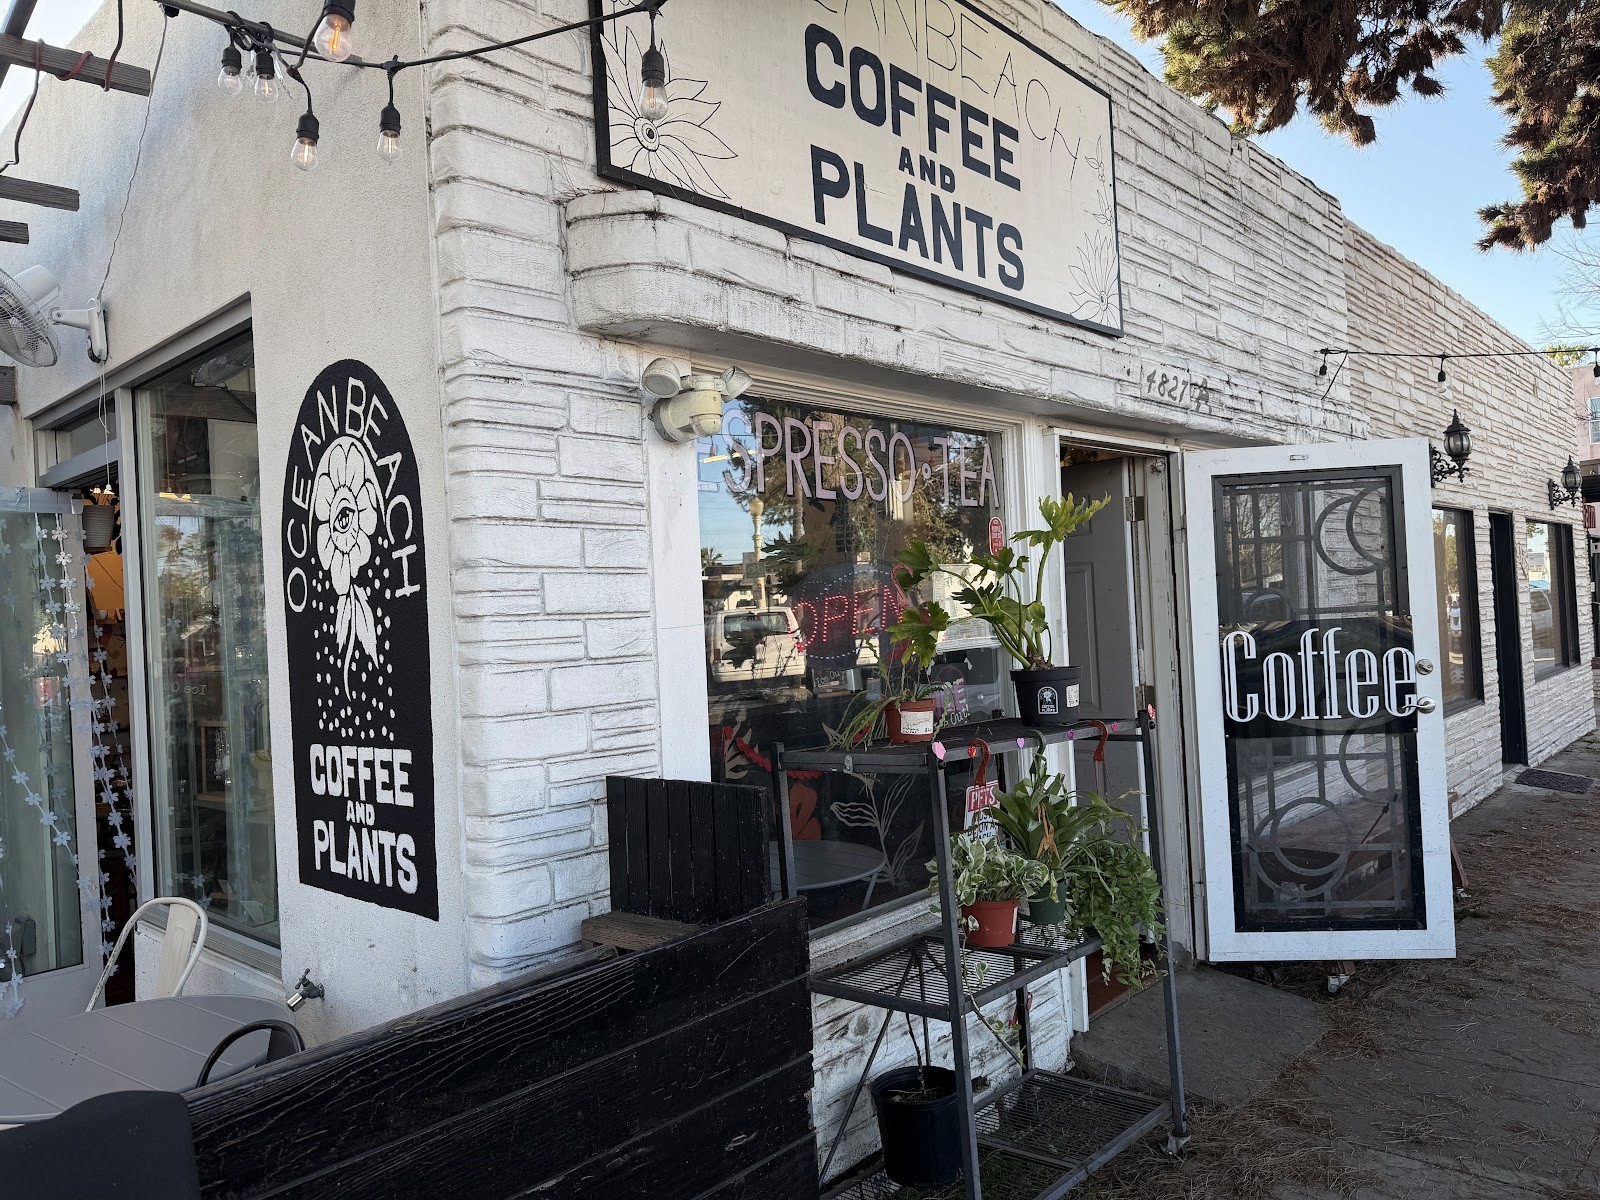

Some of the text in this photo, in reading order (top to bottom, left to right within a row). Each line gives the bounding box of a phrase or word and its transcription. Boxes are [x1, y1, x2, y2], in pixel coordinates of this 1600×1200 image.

[804, 23, 1021, 191] COFFEE
[899, 146, 956, 194] AND
[810, 144, 1025, 292] PLANTS
[1146, 369, 1189, 402] 4827
[933, 435, 1000, 508] TEA
[788, 584, 904, 650] OPEN
[1222, 627, 1418, 723] Coffee
[309, 743, 415, 808] COFFEE
[346, 800, 376, 827] AND
[313, 819, 419, 895] PLANTS
